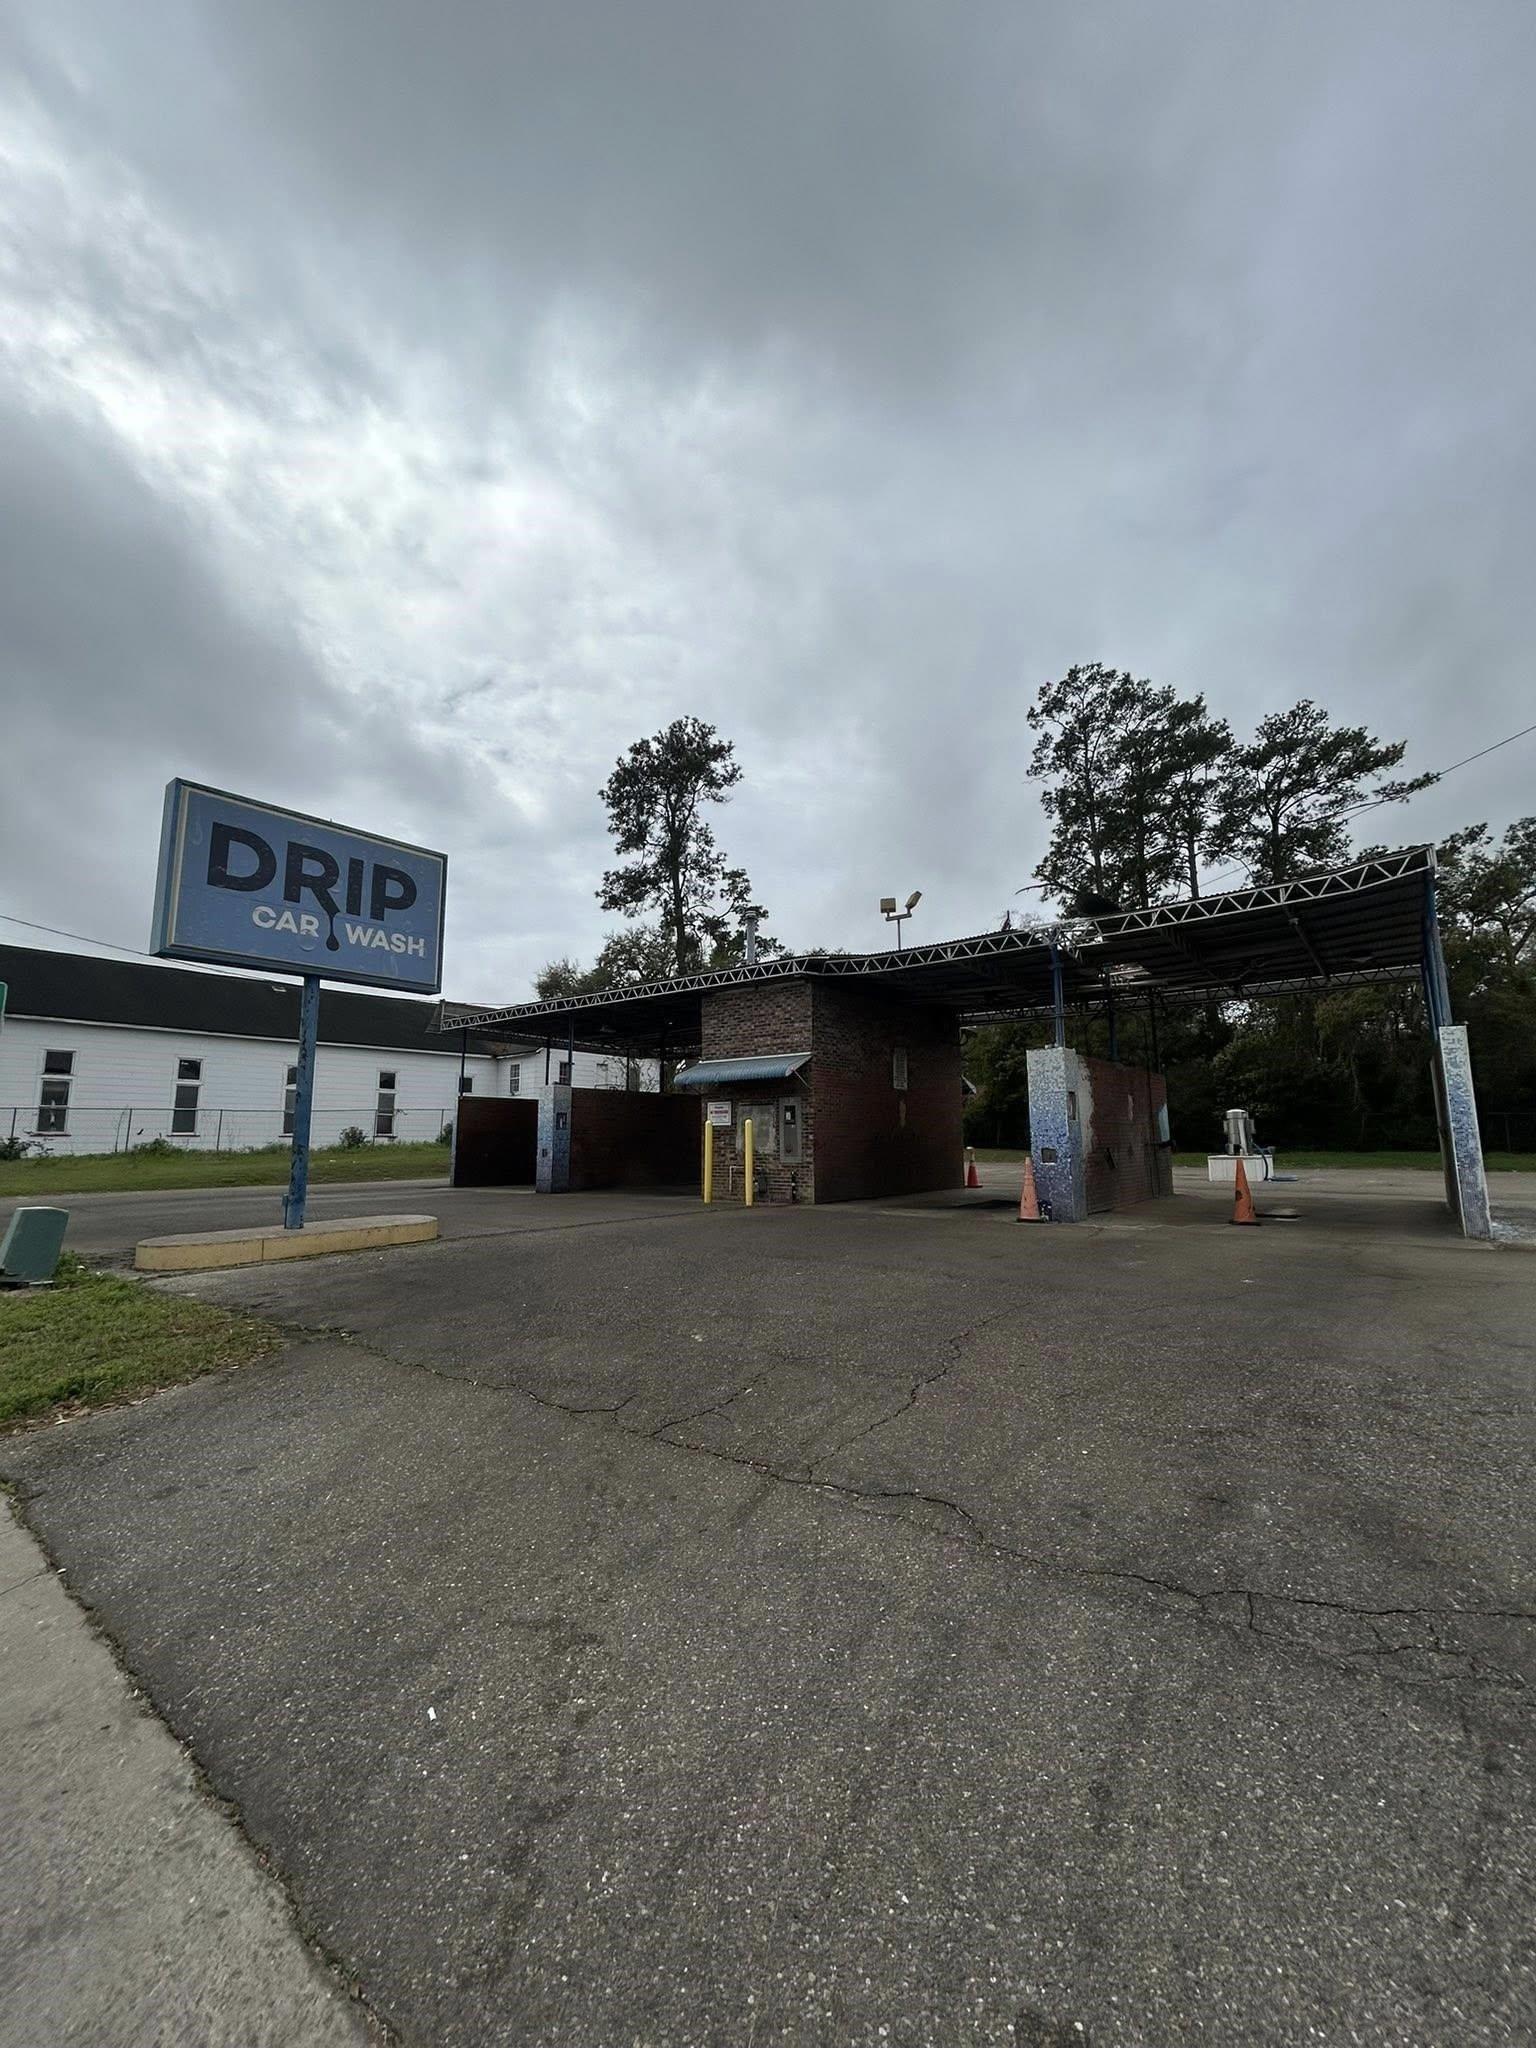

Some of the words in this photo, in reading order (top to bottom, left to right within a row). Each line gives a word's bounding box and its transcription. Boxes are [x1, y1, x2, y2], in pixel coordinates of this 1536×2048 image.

[207, 822, 417, 922] DRIP
[252, 906, 319, 938] CAR
[345, 923, 425, 957] WASH
